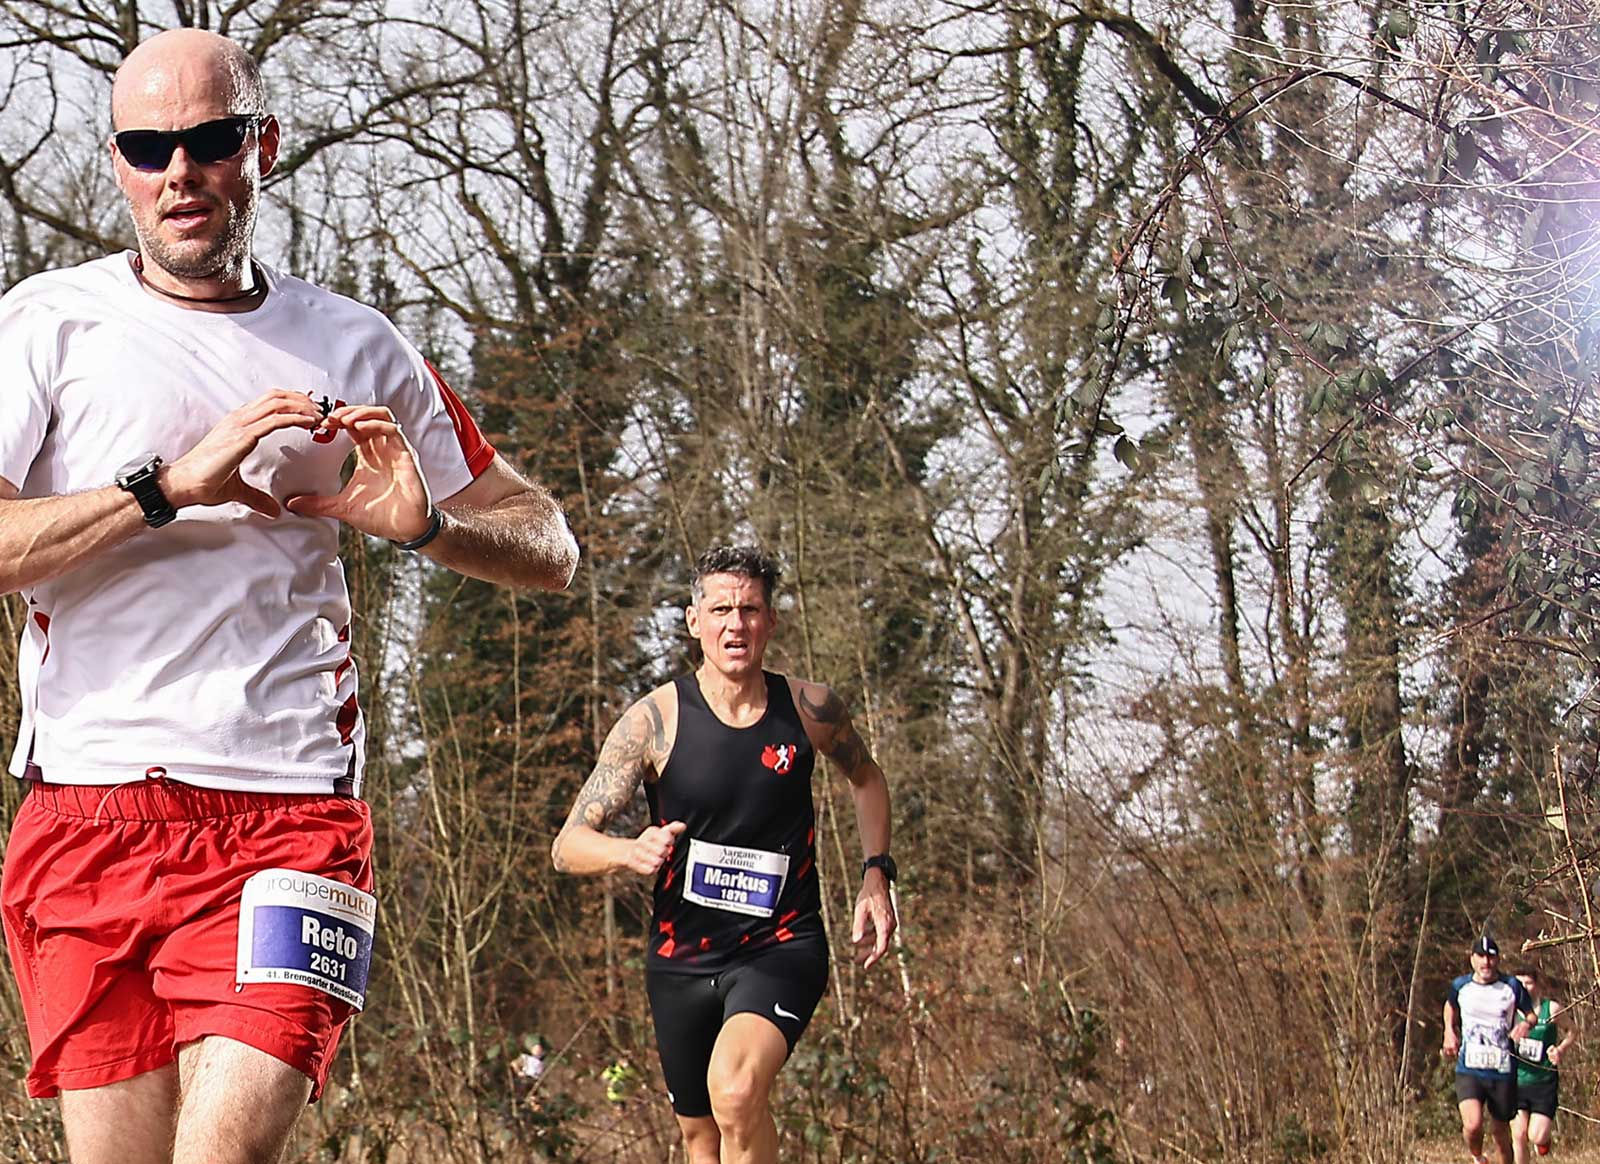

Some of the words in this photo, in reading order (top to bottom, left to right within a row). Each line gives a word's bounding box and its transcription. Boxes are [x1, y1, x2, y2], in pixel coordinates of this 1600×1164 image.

[704, 867, 769, 893] Markus
[301, 915, 357, 960] Reto
[284, 971, 328, 989] Bremgarter
[310, 952, 346, 981] 2631
